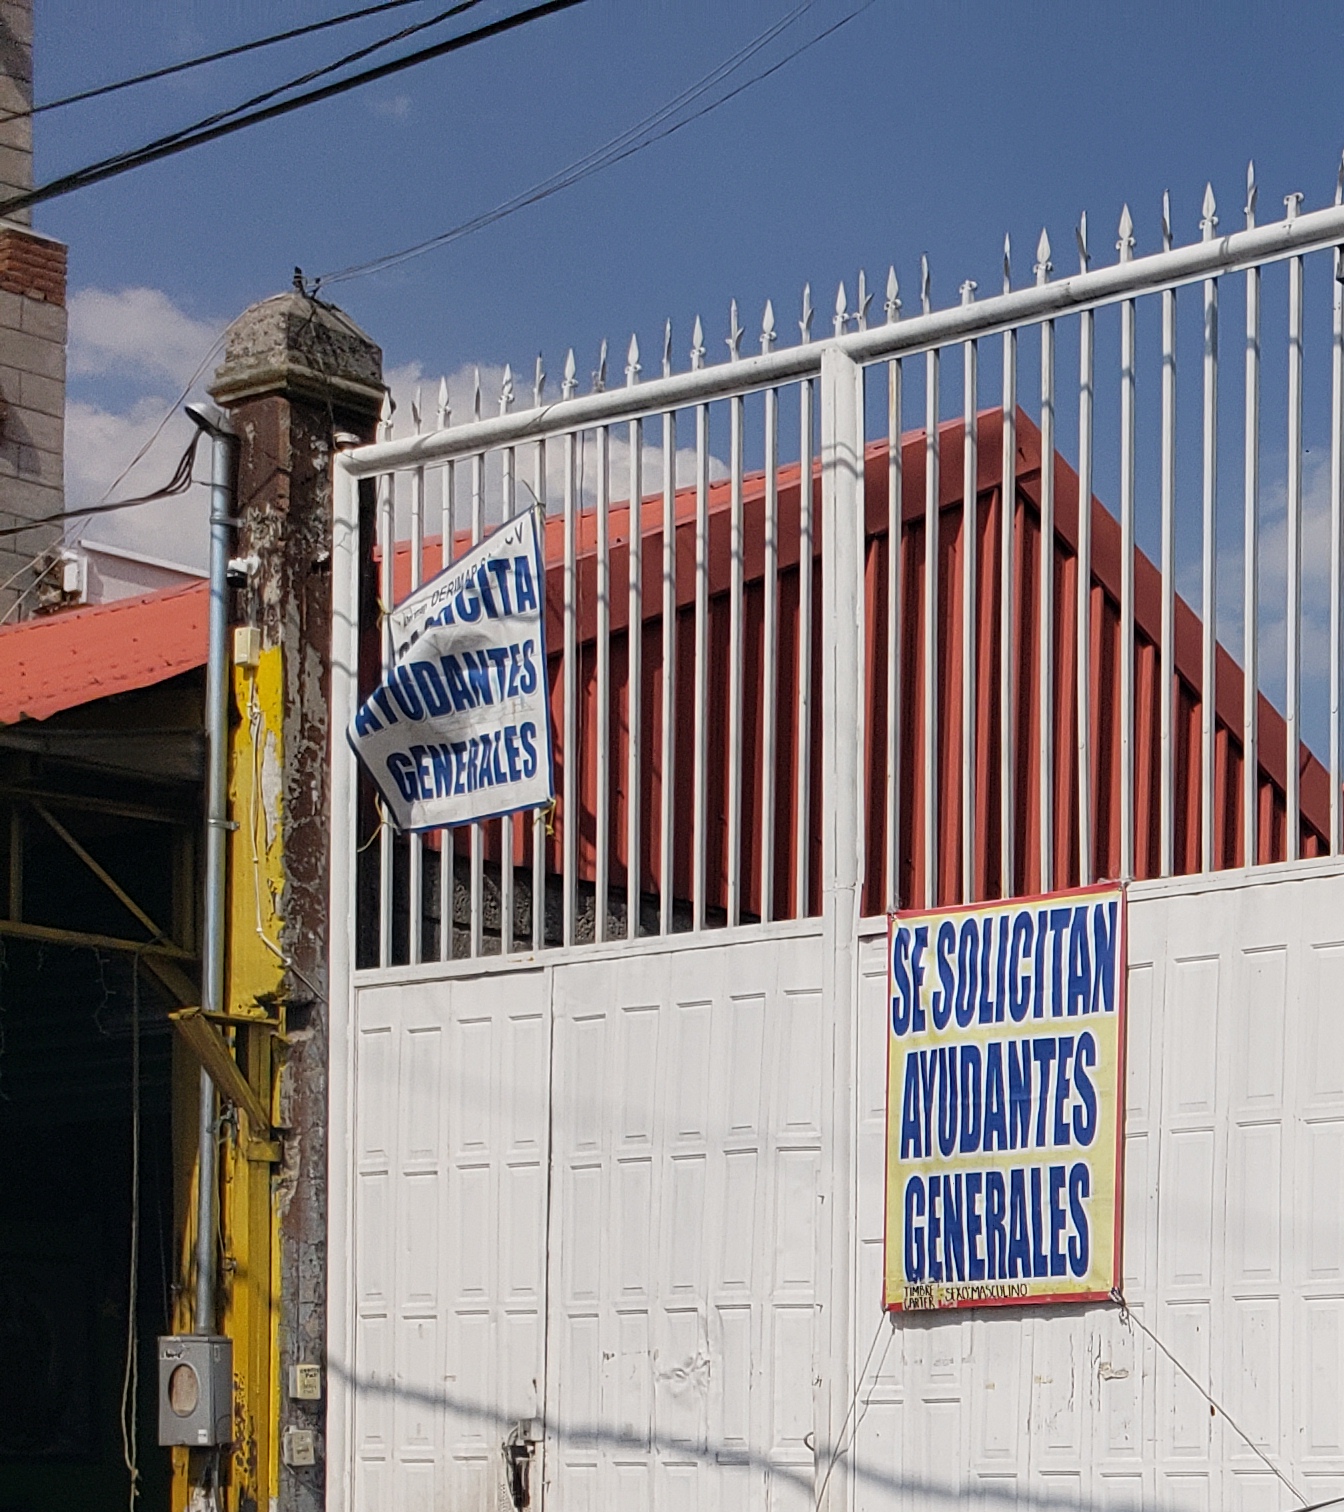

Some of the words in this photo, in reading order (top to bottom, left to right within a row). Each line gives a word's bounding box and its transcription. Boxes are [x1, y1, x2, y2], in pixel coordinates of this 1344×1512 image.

[355, 639, 538, 738] AYUDANTES
[386, 721, 538, 803] GENERALES
[892, 926, 928, 1036] SE
[932, 902, 1118, 1030] SOLICITAN
[900, 1031, 1097, 1160] AYUDANTES
[904, 1162, 1090, 1283] GENERALES
